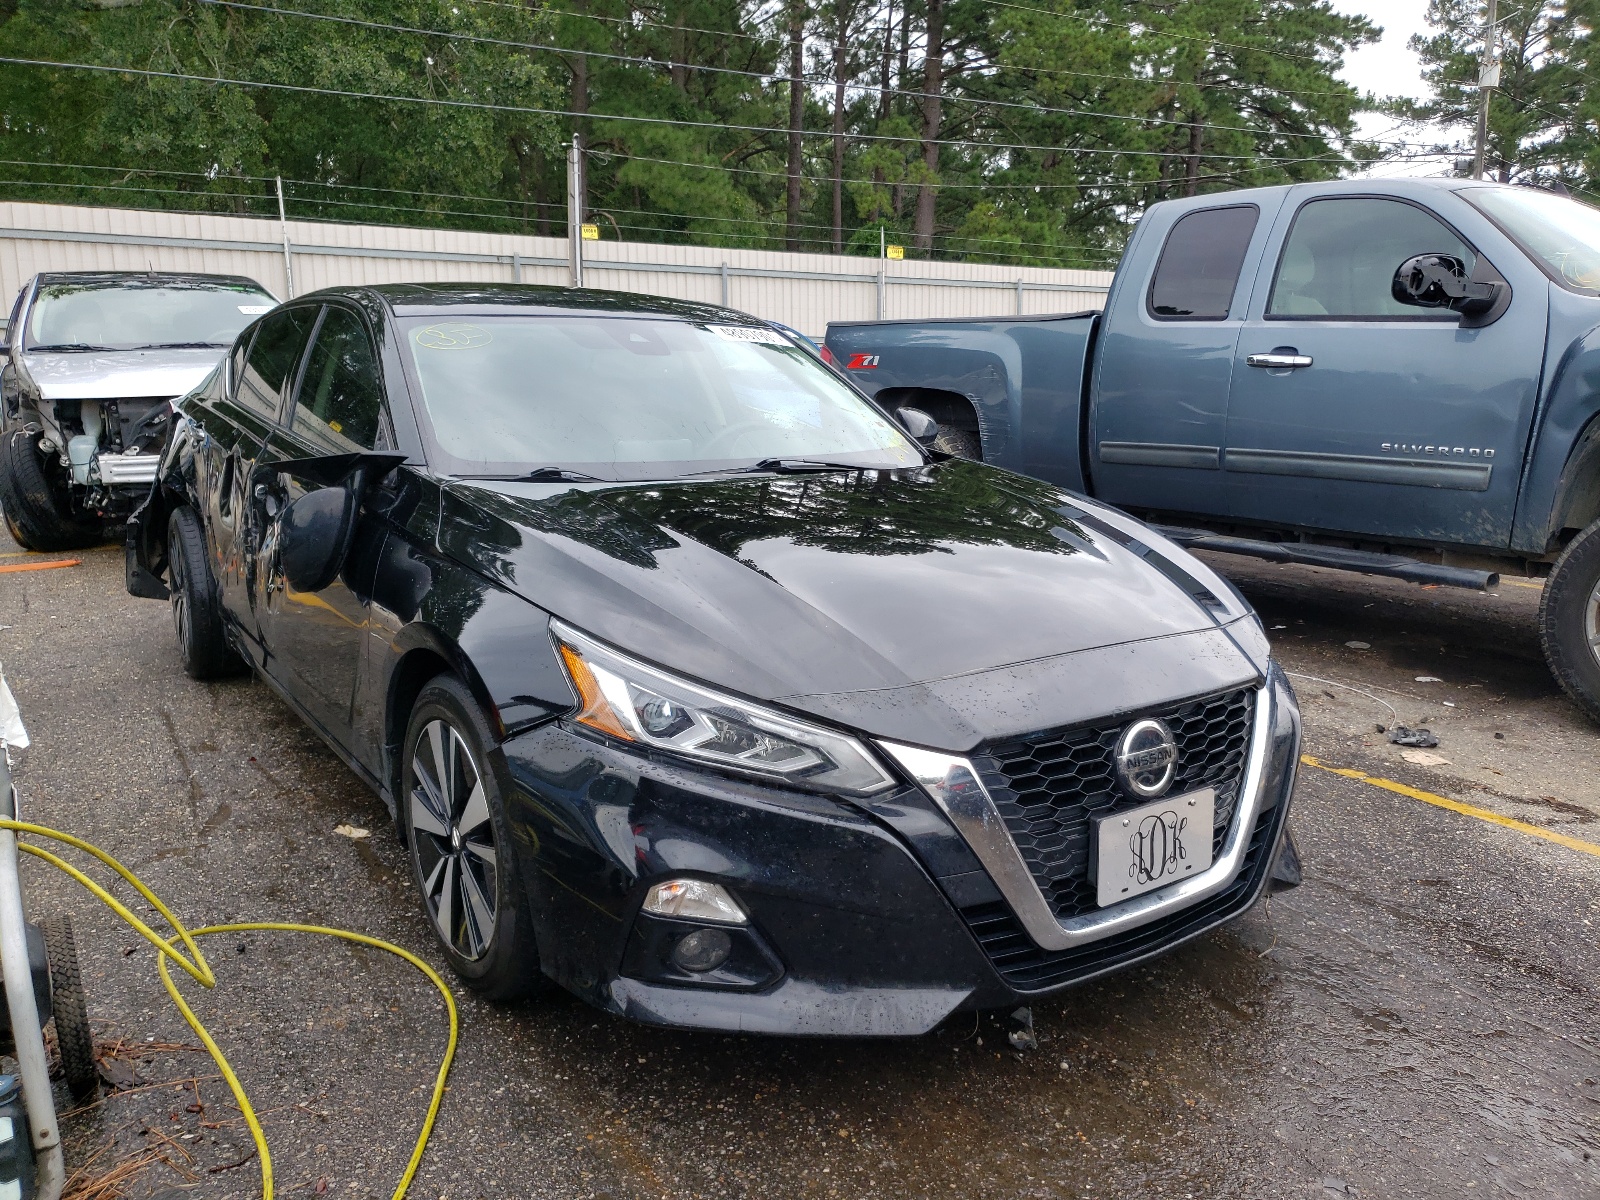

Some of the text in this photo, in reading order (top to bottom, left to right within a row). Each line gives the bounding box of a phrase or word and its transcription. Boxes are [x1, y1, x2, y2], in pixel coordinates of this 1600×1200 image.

[847, 353, 880, 369] Z71
[1380, 442, 1496, 459] SILVERADO
[1126, 749, 1172, 770] NISSAN
